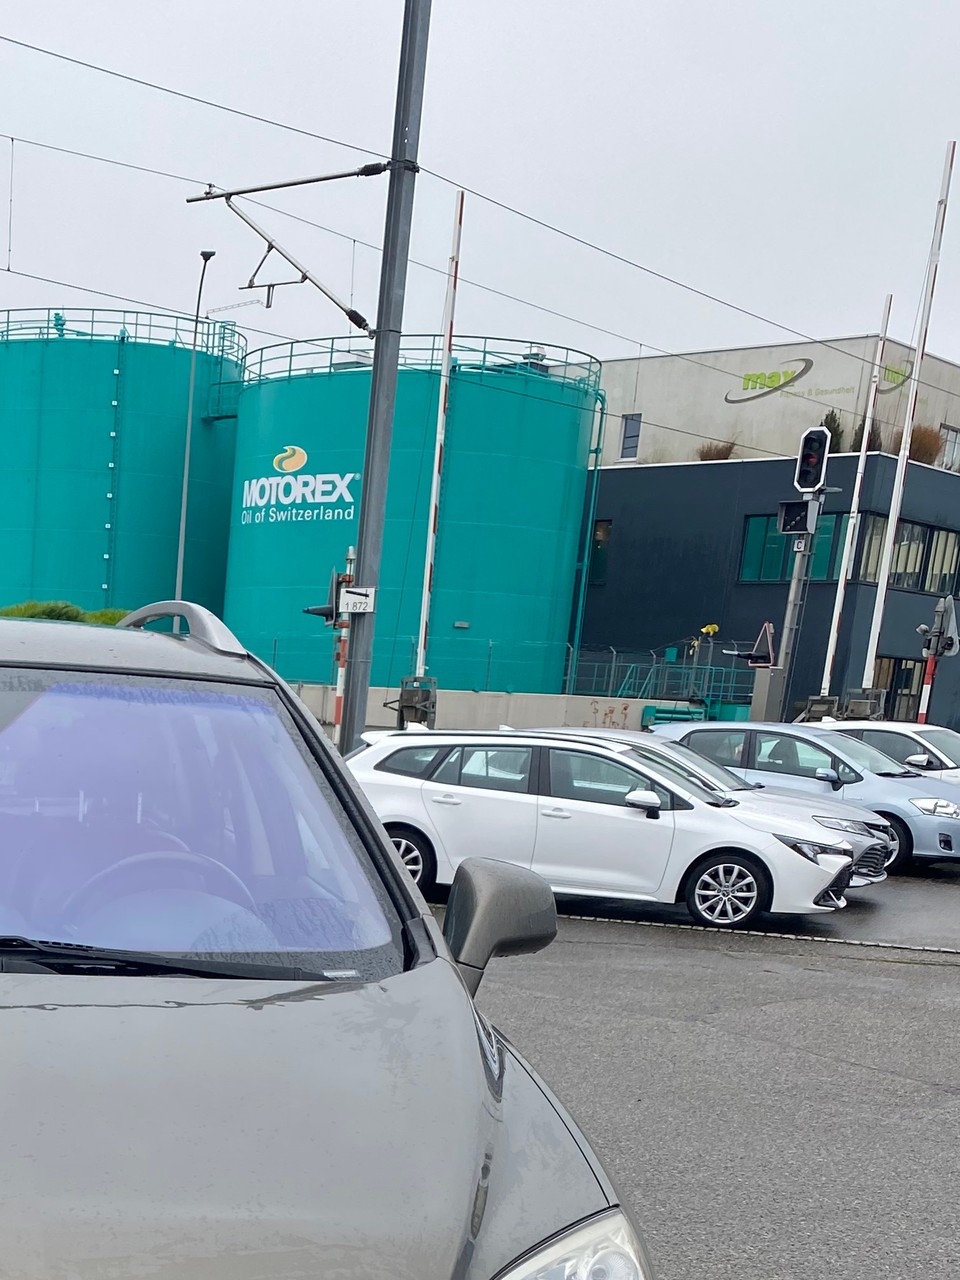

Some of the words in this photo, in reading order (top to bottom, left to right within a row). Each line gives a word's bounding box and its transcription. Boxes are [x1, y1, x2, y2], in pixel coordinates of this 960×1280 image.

[242, 473, 355, 508] MOTOREX
[241, 510, 252, 525] Oil
[255, 508, 265, 523] of
[268, 505, 355, 523] Switzerland
